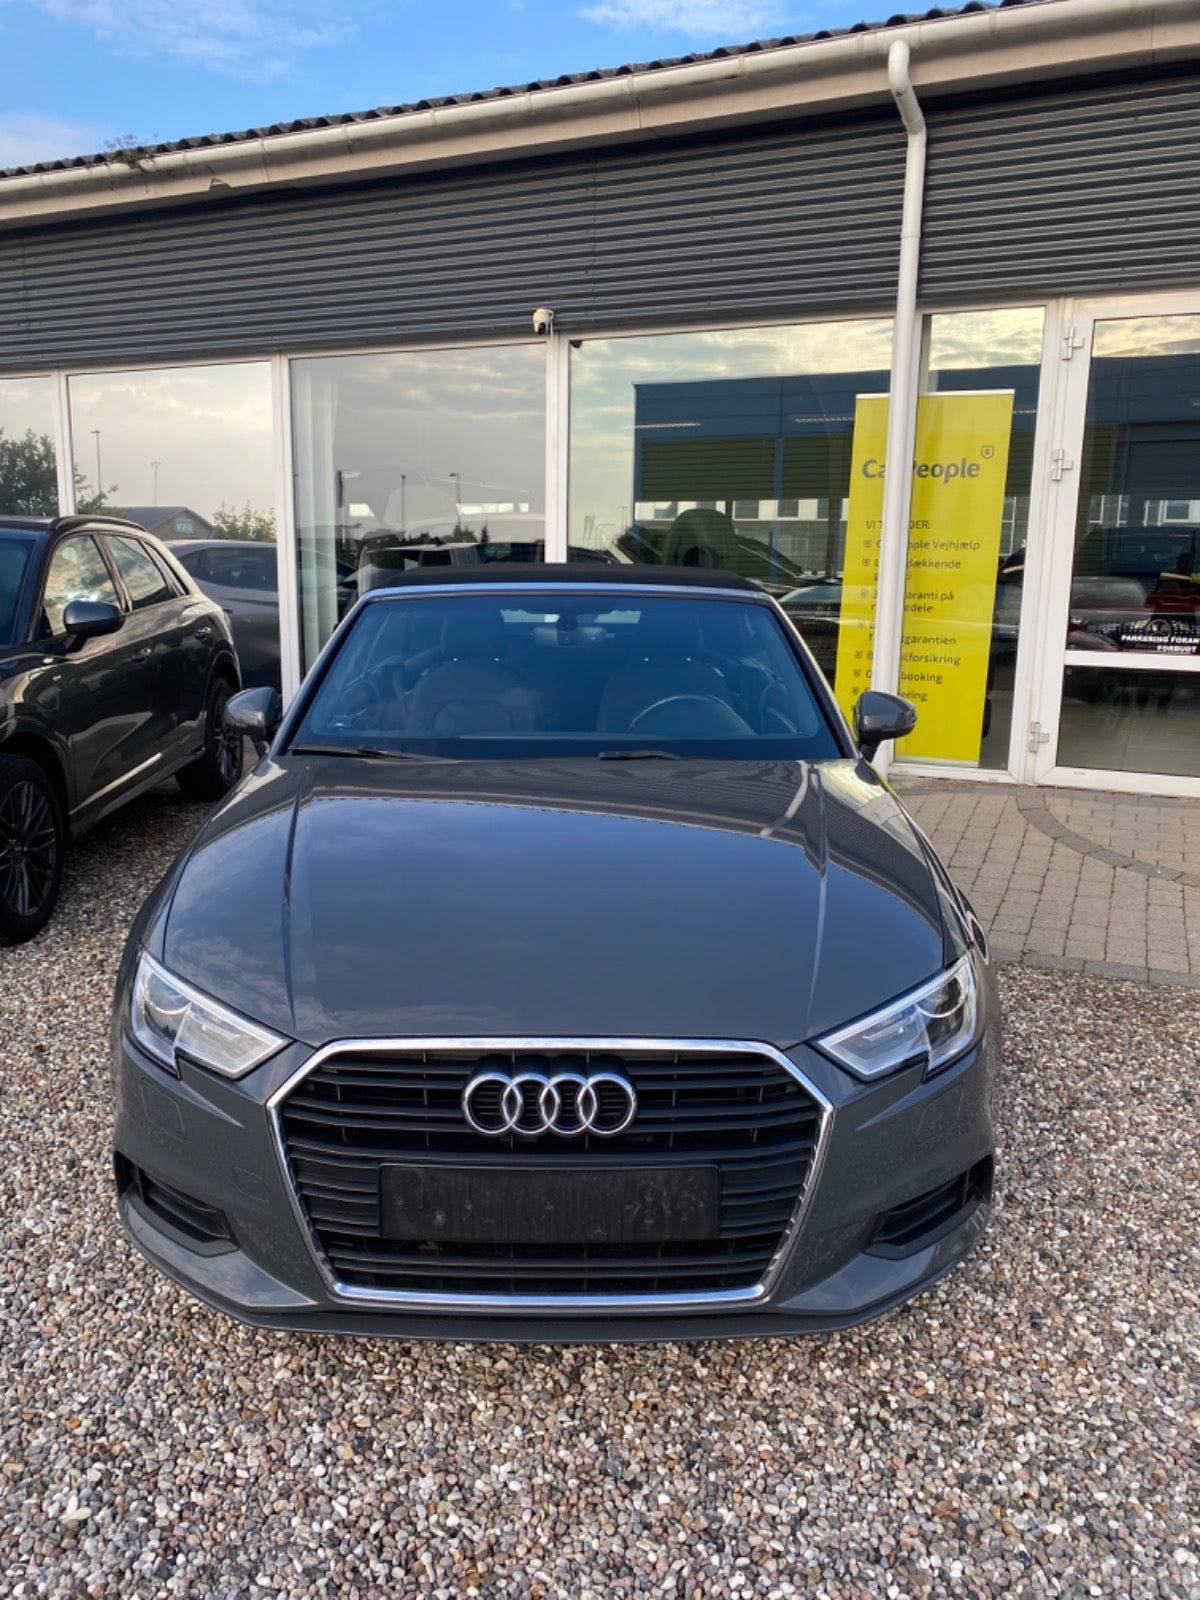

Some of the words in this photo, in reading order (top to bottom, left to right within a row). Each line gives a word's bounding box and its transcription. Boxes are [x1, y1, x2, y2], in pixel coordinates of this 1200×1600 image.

[940, 592, 954, 602] på
[1121, 635, 1169, 643] PARKERING
[1157, 645, 1197, 653] FORBUDT
